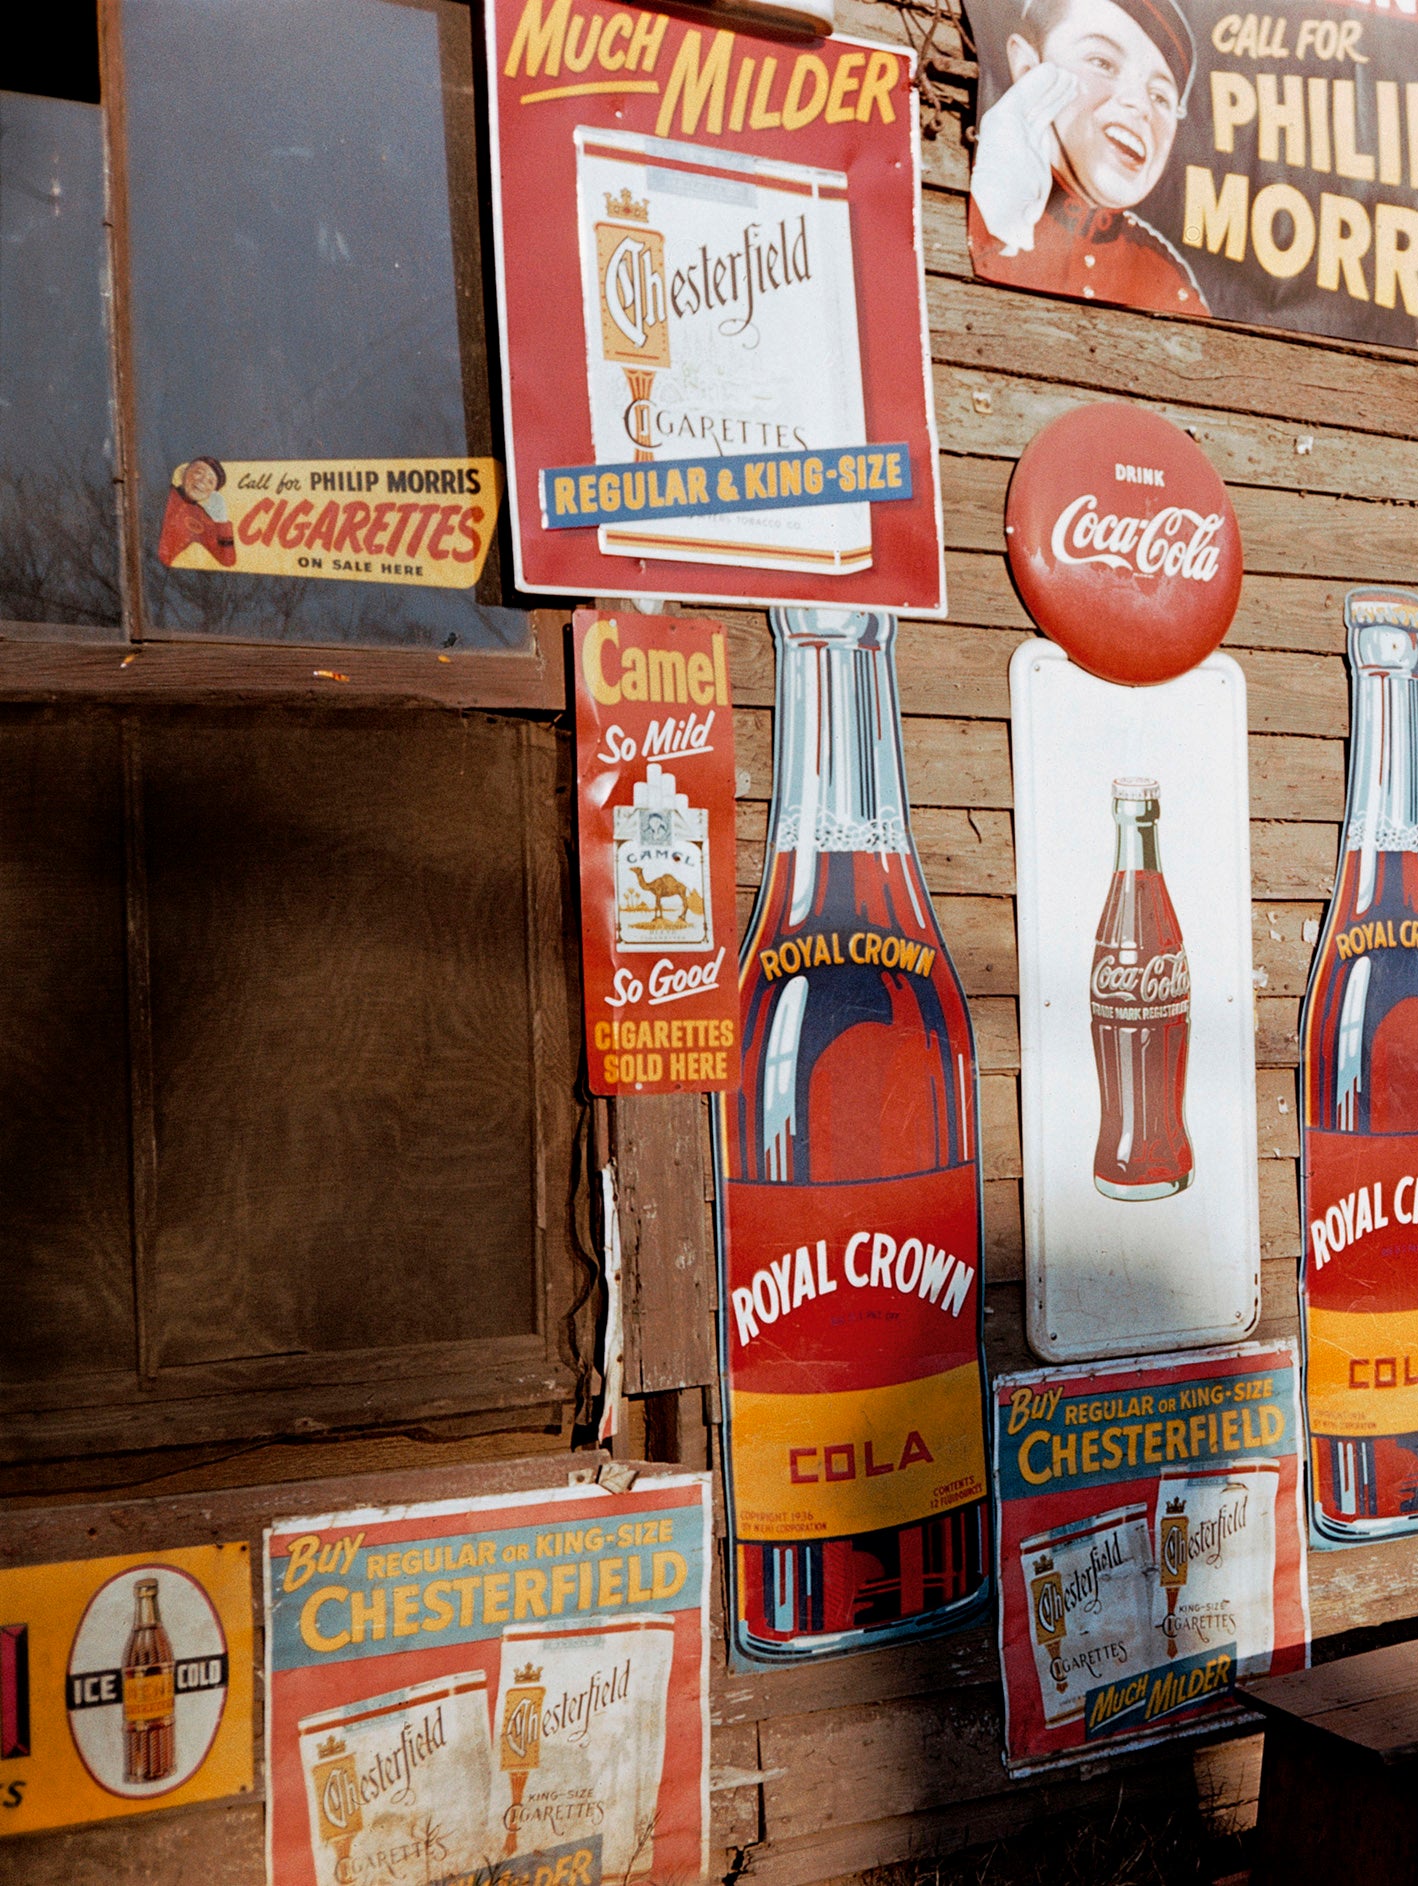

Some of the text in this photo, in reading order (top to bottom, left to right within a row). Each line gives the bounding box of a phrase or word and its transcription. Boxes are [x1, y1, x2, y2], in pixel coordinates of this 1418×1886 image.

[1211, 13, 1289, 59] CALL
[1297, 20, 1369, 64] FOR
[504, 0, 899, 137] MUCH MILDER
[604, 214, 813, 350] Chesterfield
[623, 399, 809, 456] CIGARETTES
[237, 468, 482, 495] Call for PHILIP MORRIS
[554, 453, 902, 516] REGULAR & KING-SIZE
[1115, 463, 1165, 487] DRINK
[238, 497, 485, 563] CIGARETTES
[1051, 494, 1225, 582] Coca-Cola
[298, 557, 423, 577] ON SALE HERE
[582, 619, 728, 706] Camel
[598, 709, 716, 764] So Mild
[626, 850, 695, 868] CAMEL
[760, 932, 935, 981] ROYAL CROWN
[1335, 920, 1397, 961] ROYAL
[604, 946, 727, 1007] So Good
[594, 1019, 734, 1050] CIGARETTES
[603, 1051, 728, 1084] SOLD HERE
[1311, 1182, 1389, 1271] ROYAL
[732, 1232, 974, 1347] ROYAL CROWN
[1065, 1395, 1154, 1426] REGULAR
[1158, 1398, 1176, 1413] OR
[1179, 1378, 1274, 1411] KING-SIZE
[789, 1430, 934, 1484] COLA
[1017, 1404, 1285, 1486] CHESTERFIELD
[366, 1541, 496, 1580] REGULAR
[502, 1544, 529, 1563] OR
[536, 1518, 674, 1559] KING-SIZE
[1163, 1496, 1248, 1576] Chesterfield
[300, 1550, 689, 1653] CHESTERFIELD
[1038, 1531, 1124, 1633] Chesterfield
[1178, 1600, 1230, 1614] KING-SIZE
[1161, 1613, 1237, 1644] CIGARETTES
[74, 1675, 117, 1704] ICE
[177, 1659, 222, 1689] COLD
[1050, 1640, 1127, 1683] CIGARETTES
[503, 1659, 631, 1760] Chesterfield
[1089, 1654, 1231, 1728] MUCH MILDER
[322, 1706, 448, 1830] Chesterfield
[527, 1787, 594, 1801] KING-SIZE
[503, 1802, 604, 1836] CIGARETTES
[335, 1838, 449, 1886] CIGARETTES
